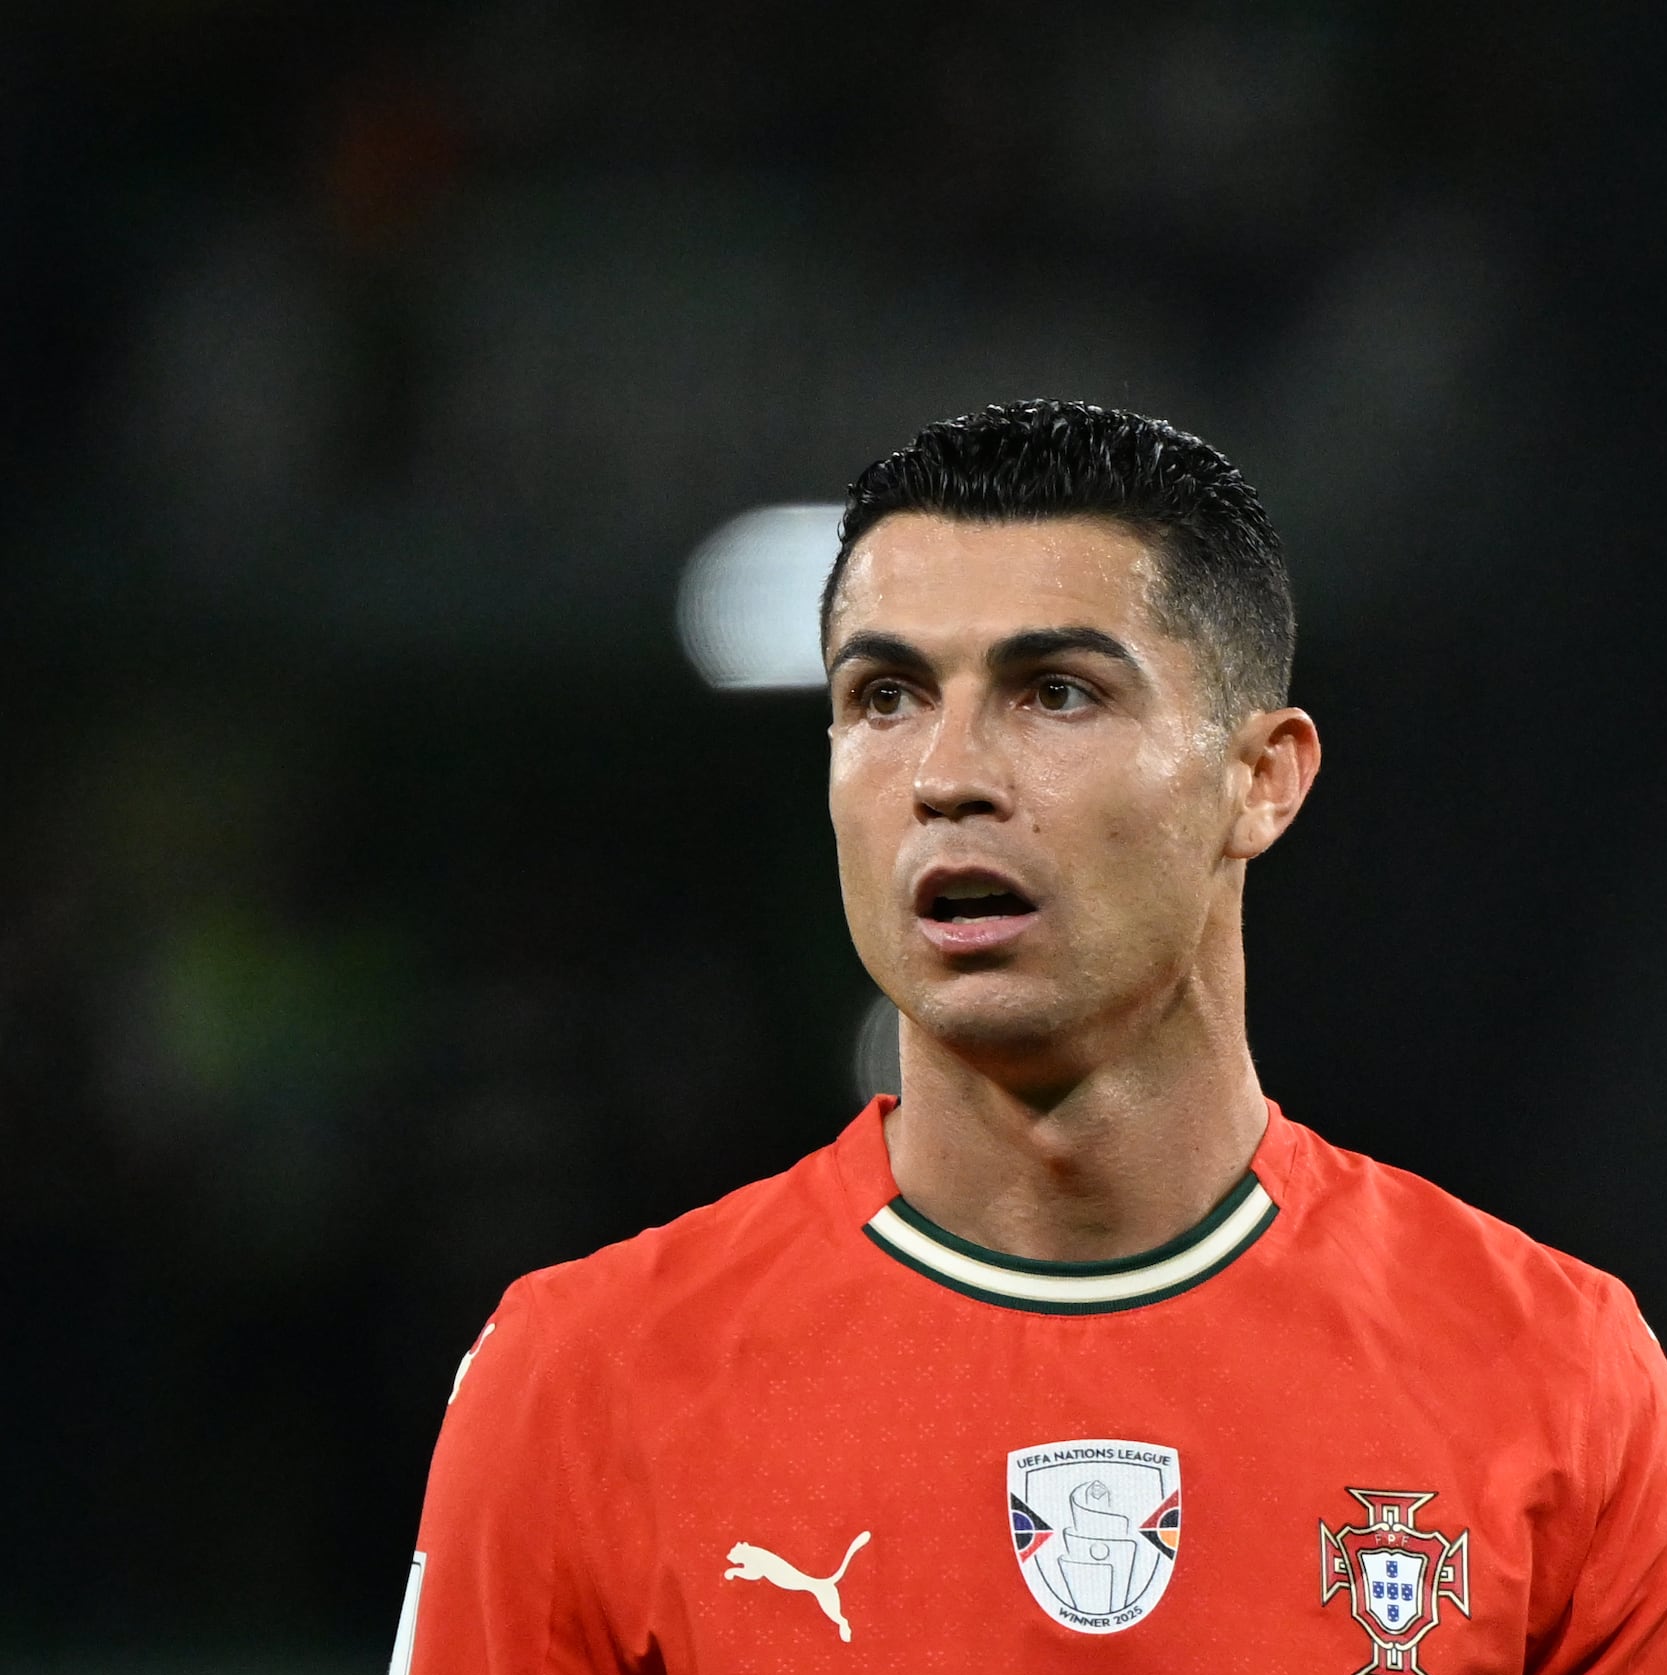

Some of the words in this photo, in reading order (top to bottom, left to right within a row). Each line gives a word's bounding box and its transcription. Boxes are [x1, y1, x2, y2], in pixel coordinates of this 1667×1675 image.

[1017, 1455, 1050, 1469] UEFA
[1054, 1448, 1114, 1461] NATIONS
[1118, 1449, 1172, 1466] LEAGUE
[1059, 1607, 1111, 1627] WINNER
[1113, 1605, 1143, 1625] 2025
